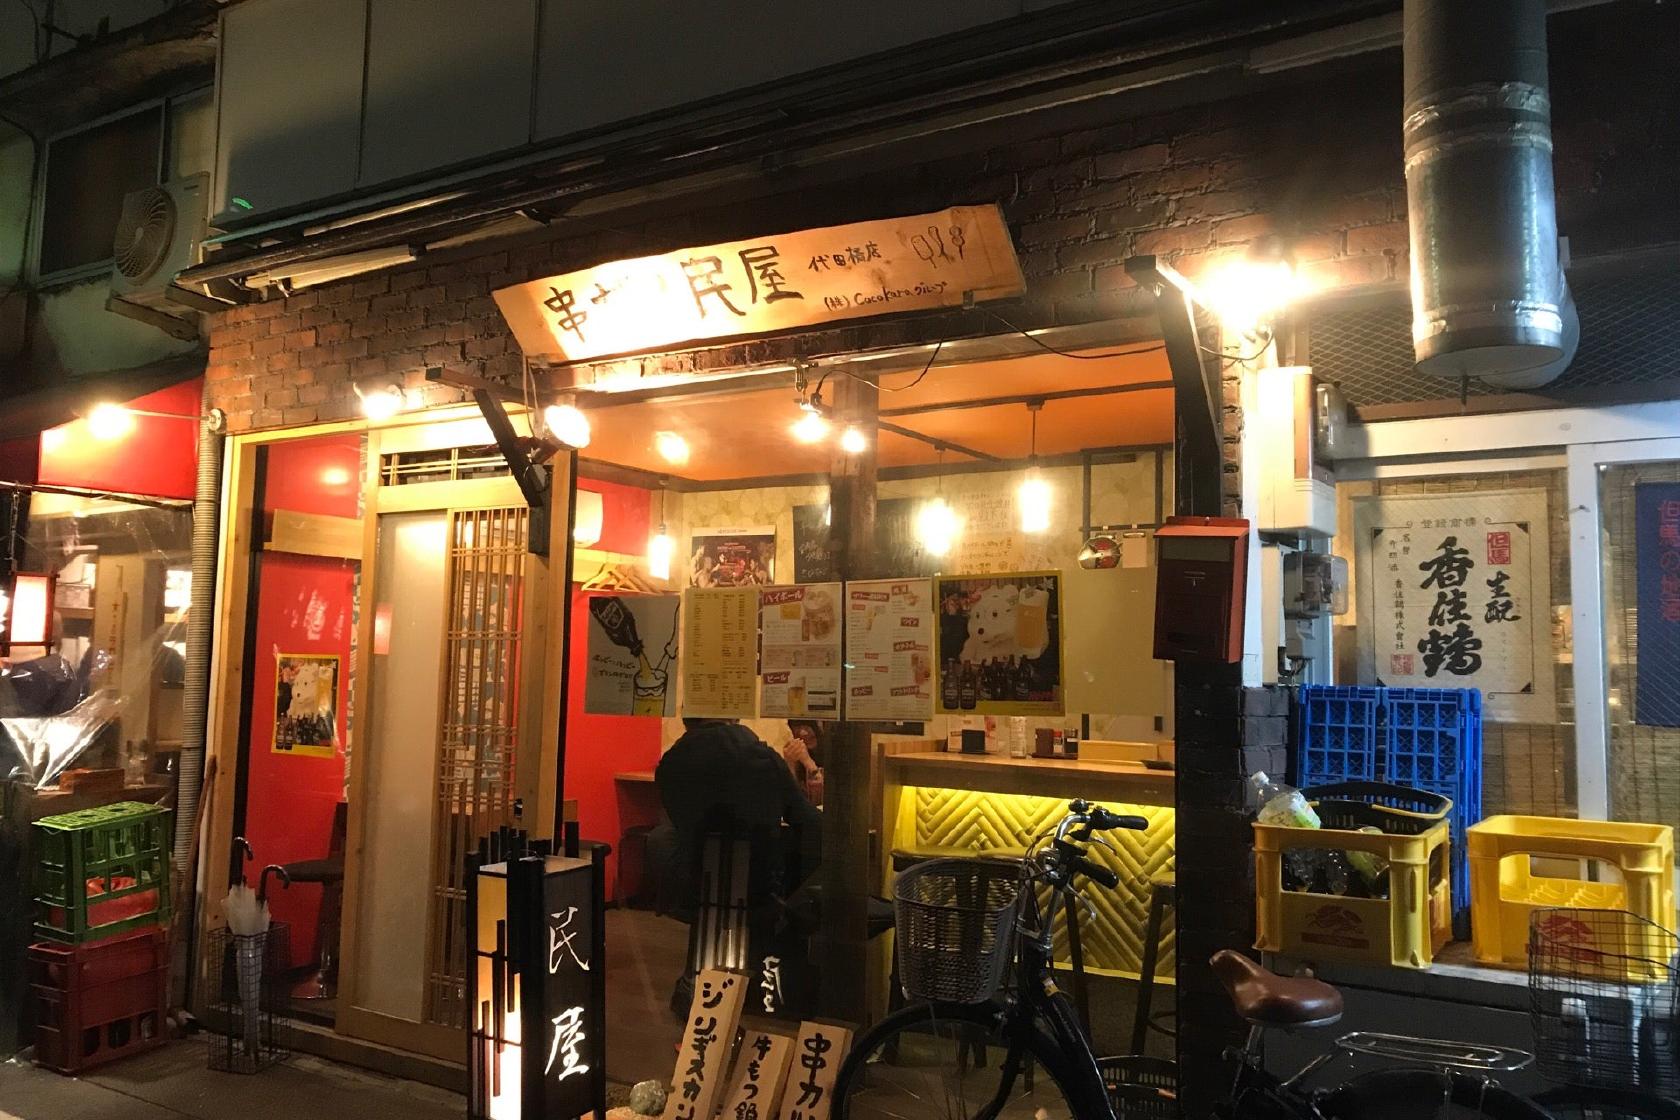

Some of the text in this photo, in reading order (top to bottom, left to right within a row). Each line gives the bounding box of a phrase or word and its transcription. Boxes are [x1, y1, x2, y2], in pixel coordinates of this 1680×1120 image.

[808, 241, 881, 272] 代田橋店
[765, 589, 802, 603] ハイボール
